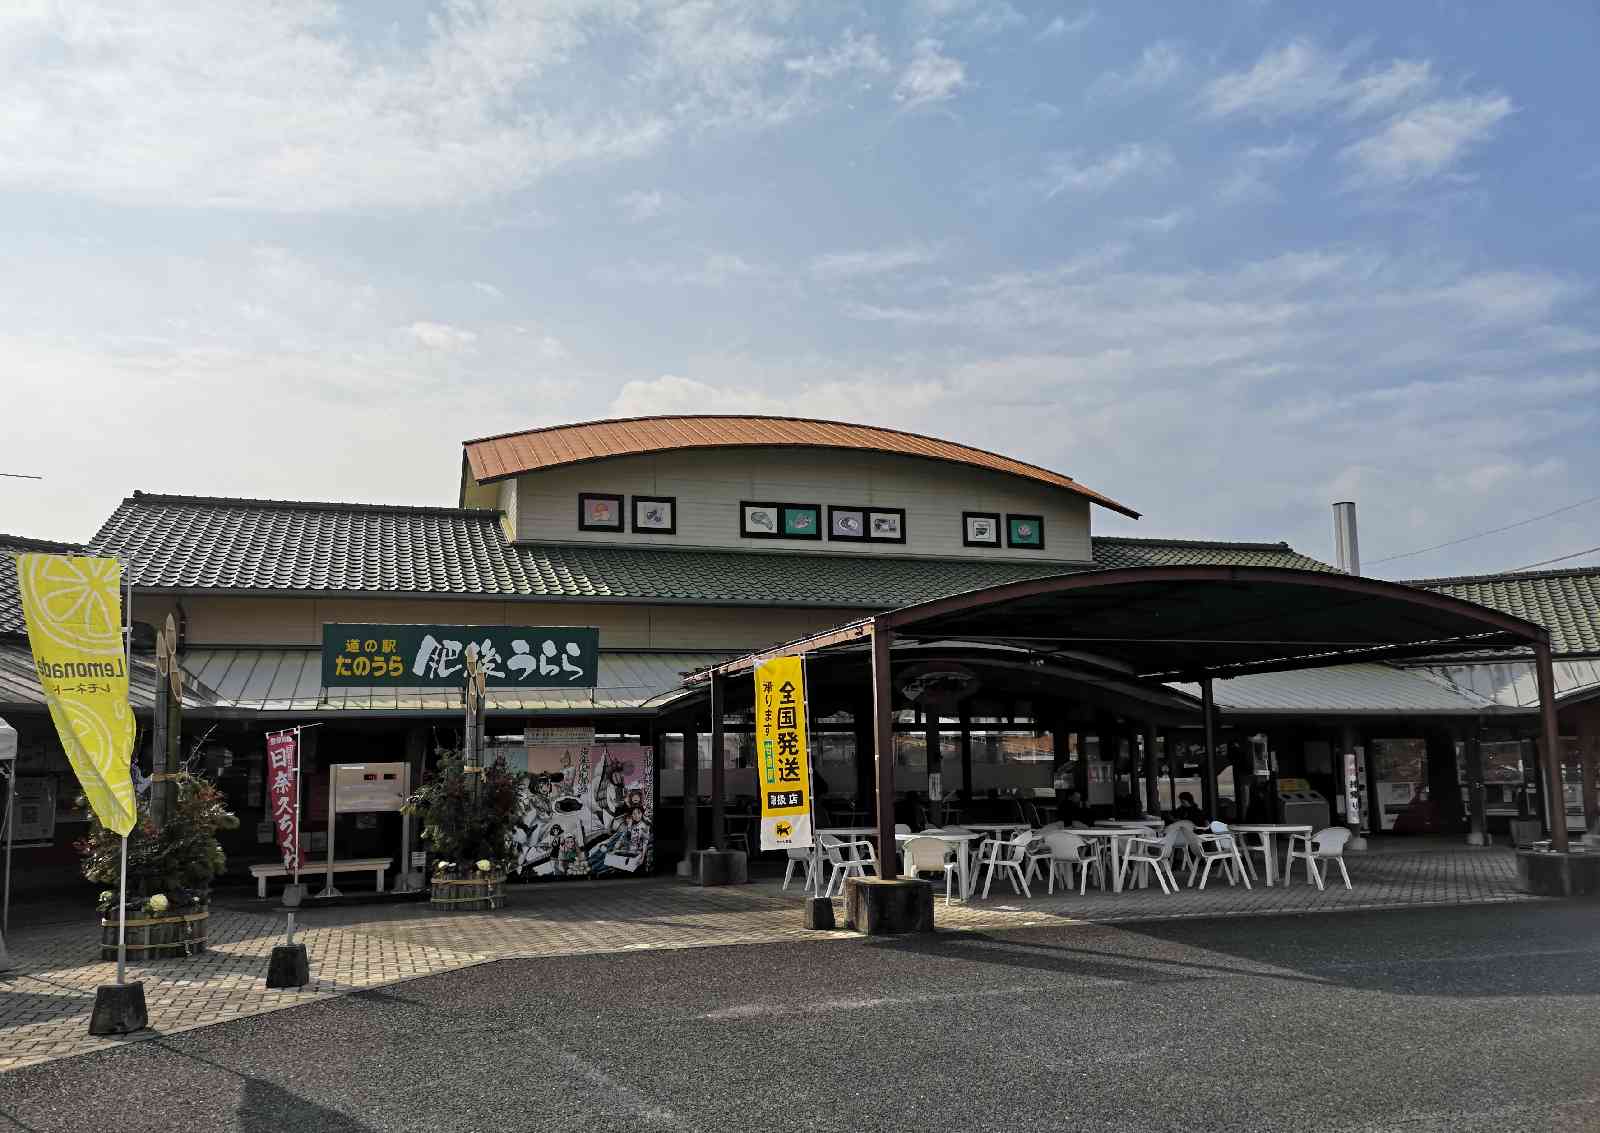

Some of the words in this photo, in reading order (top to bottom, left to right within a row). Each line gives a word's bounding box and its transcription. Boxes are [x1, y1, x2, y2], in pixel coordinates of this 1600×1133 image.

[335, 655, 404, 677] たのうら
[345, 639, 397, 653] 道の駅
[412, 634, 584, 680] 肥後うらら
[762, 681, 773, 737] 承ります
[777, 681, 801, 782] 全国発送
